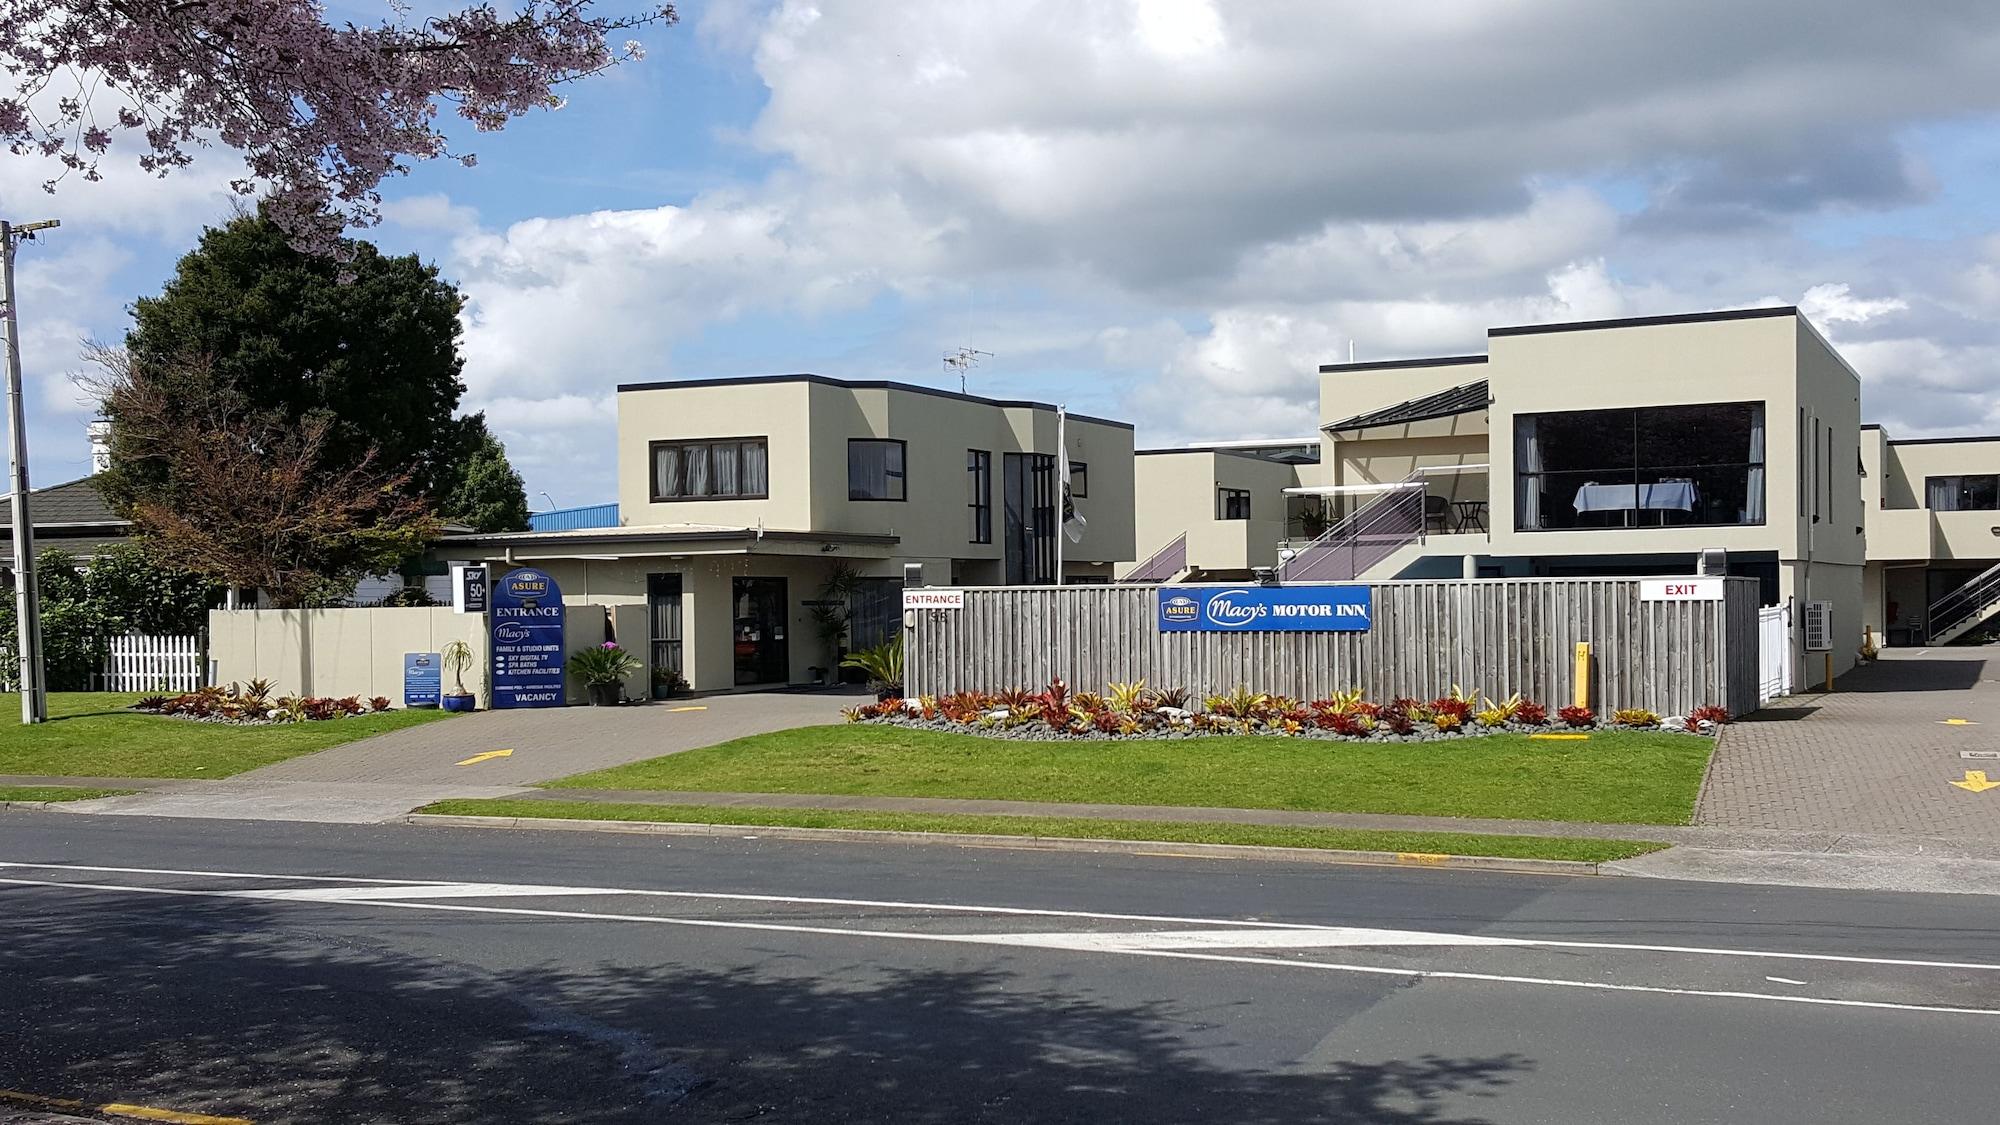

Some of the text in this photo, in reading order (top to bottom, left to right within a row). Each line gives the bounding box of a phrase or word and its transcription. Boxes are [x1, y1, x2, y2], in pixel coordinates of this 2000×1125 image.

[465, 571, 482, 580] SKY
[511, 582, 545, 590] ASURE
[1665, 584, 1697, 595] EXIT
[905, 595, 961, 604] ENTRANCE
[496, 607, 560, 617] ENTRANCE
[1166, 606, 1196, 614] ASURE
[1209, 596, 1366, 622] Macy's MOTOR INN
[495, 624, 530, 642] Macy's
[496, 645, 516, 653] FAMILY
[515, 693, 557, 701] VACANCY
